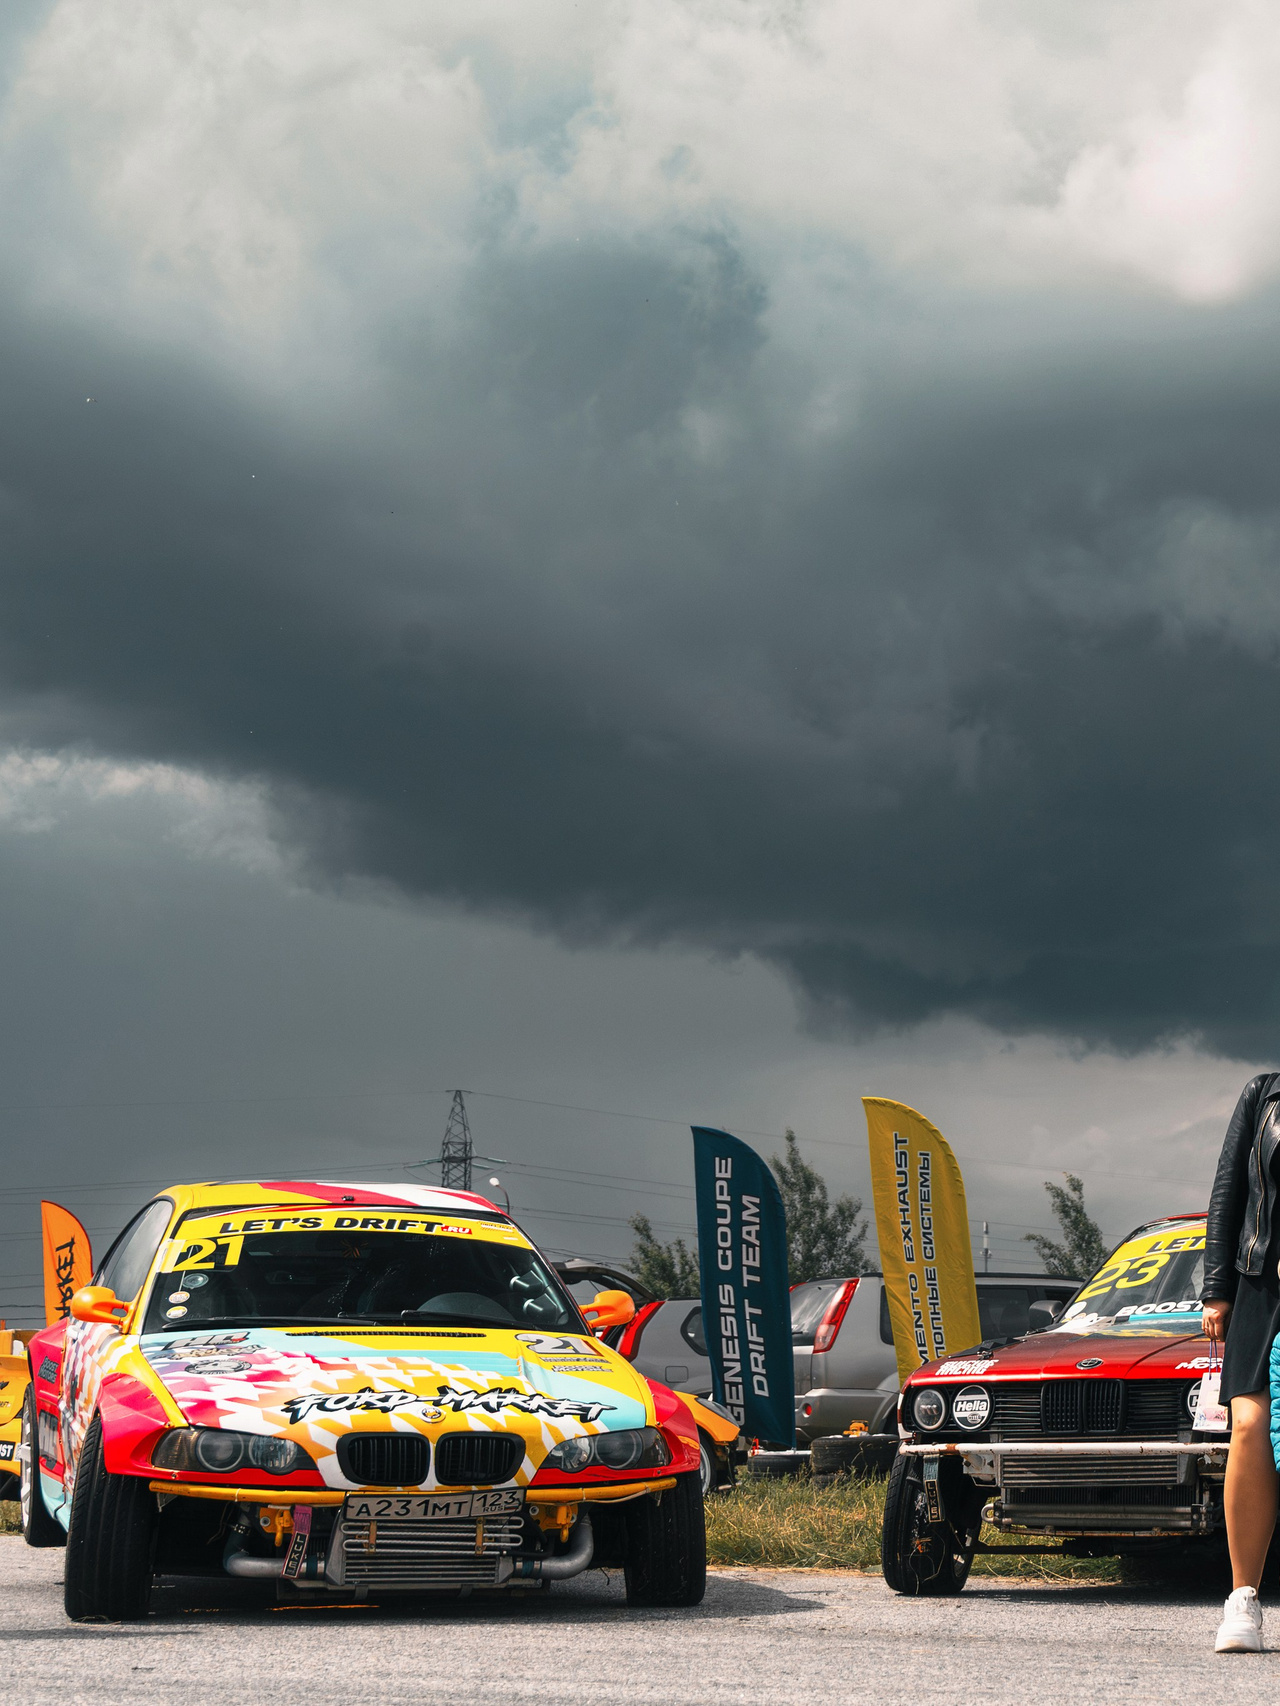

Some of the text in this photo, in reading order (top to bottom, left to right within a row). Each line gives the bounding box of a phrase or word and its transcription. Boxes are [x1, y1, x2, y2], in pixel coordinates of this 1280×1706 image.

[893, 1132, 914, 1263] EXHAUST
[918, 1151, 934, 1261] СИСТЕМЫ
[219, 1217, 325, 1234] LET'S
[173, 1235, 245, 1272] 21
[714, 1157, 745, 1426] GENESIS COUPE
[741, 1195, 770, 1397] DRIFT TEAM
[1075, 1253, 1170, 1303] 23
[514, 1333, 604, 1357] 21
[282, 1386, 618, 1424] FORD-MARKET
[956, 1400, 988, 1411] Hella
[475, 1491, 518, 1507] 123
[482, 1505, 505, 1513] RUS
[287, 1535, 304, 1570] LUKE
